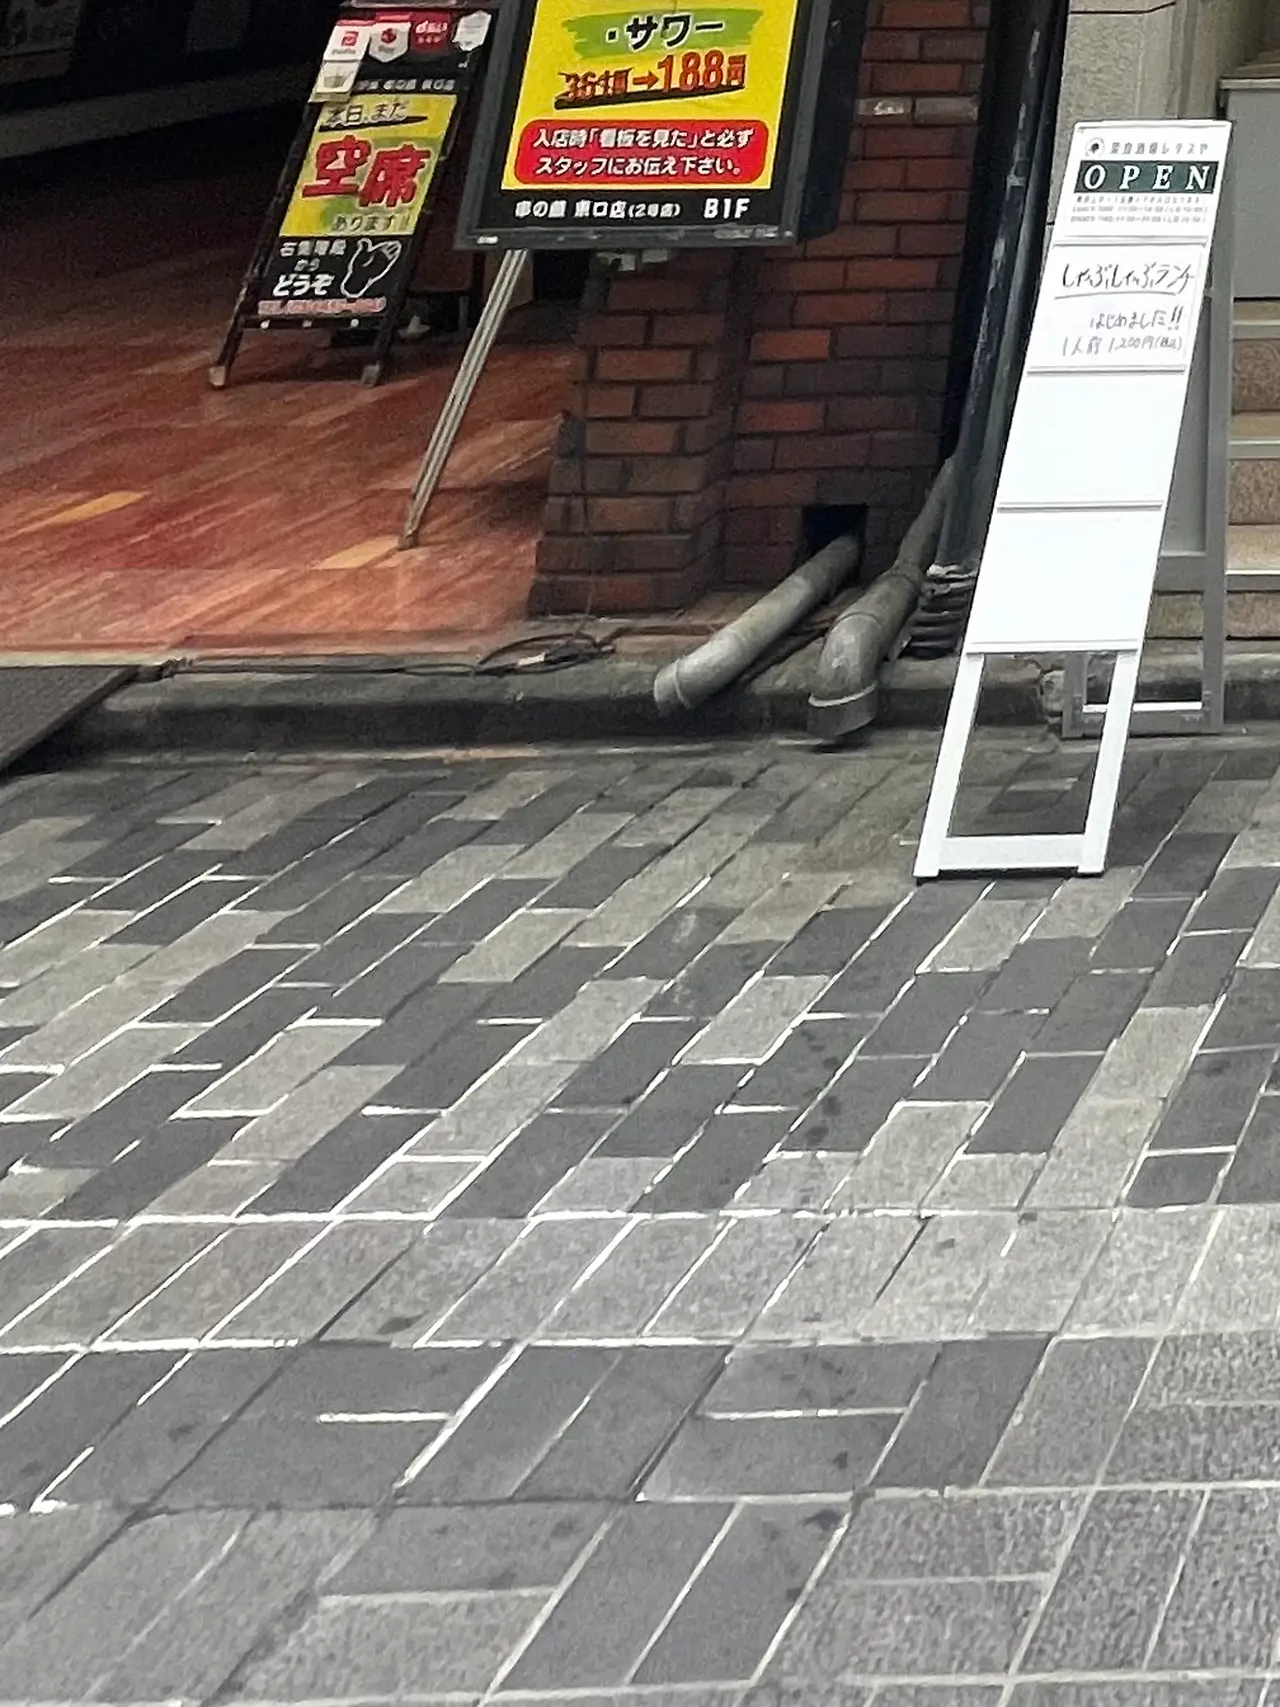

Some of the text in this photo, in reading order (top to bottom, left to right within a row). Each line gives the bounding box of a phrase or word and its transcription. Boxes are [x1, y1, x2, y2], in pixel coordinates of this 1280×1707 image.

[301, 134, 432, 208] 空席
[534, 155, 742, 177] スタッフにお伝え下さい。
[1083, 163, 1211, 191] OPEN
[272, 273, 336, 298] どうぞ
